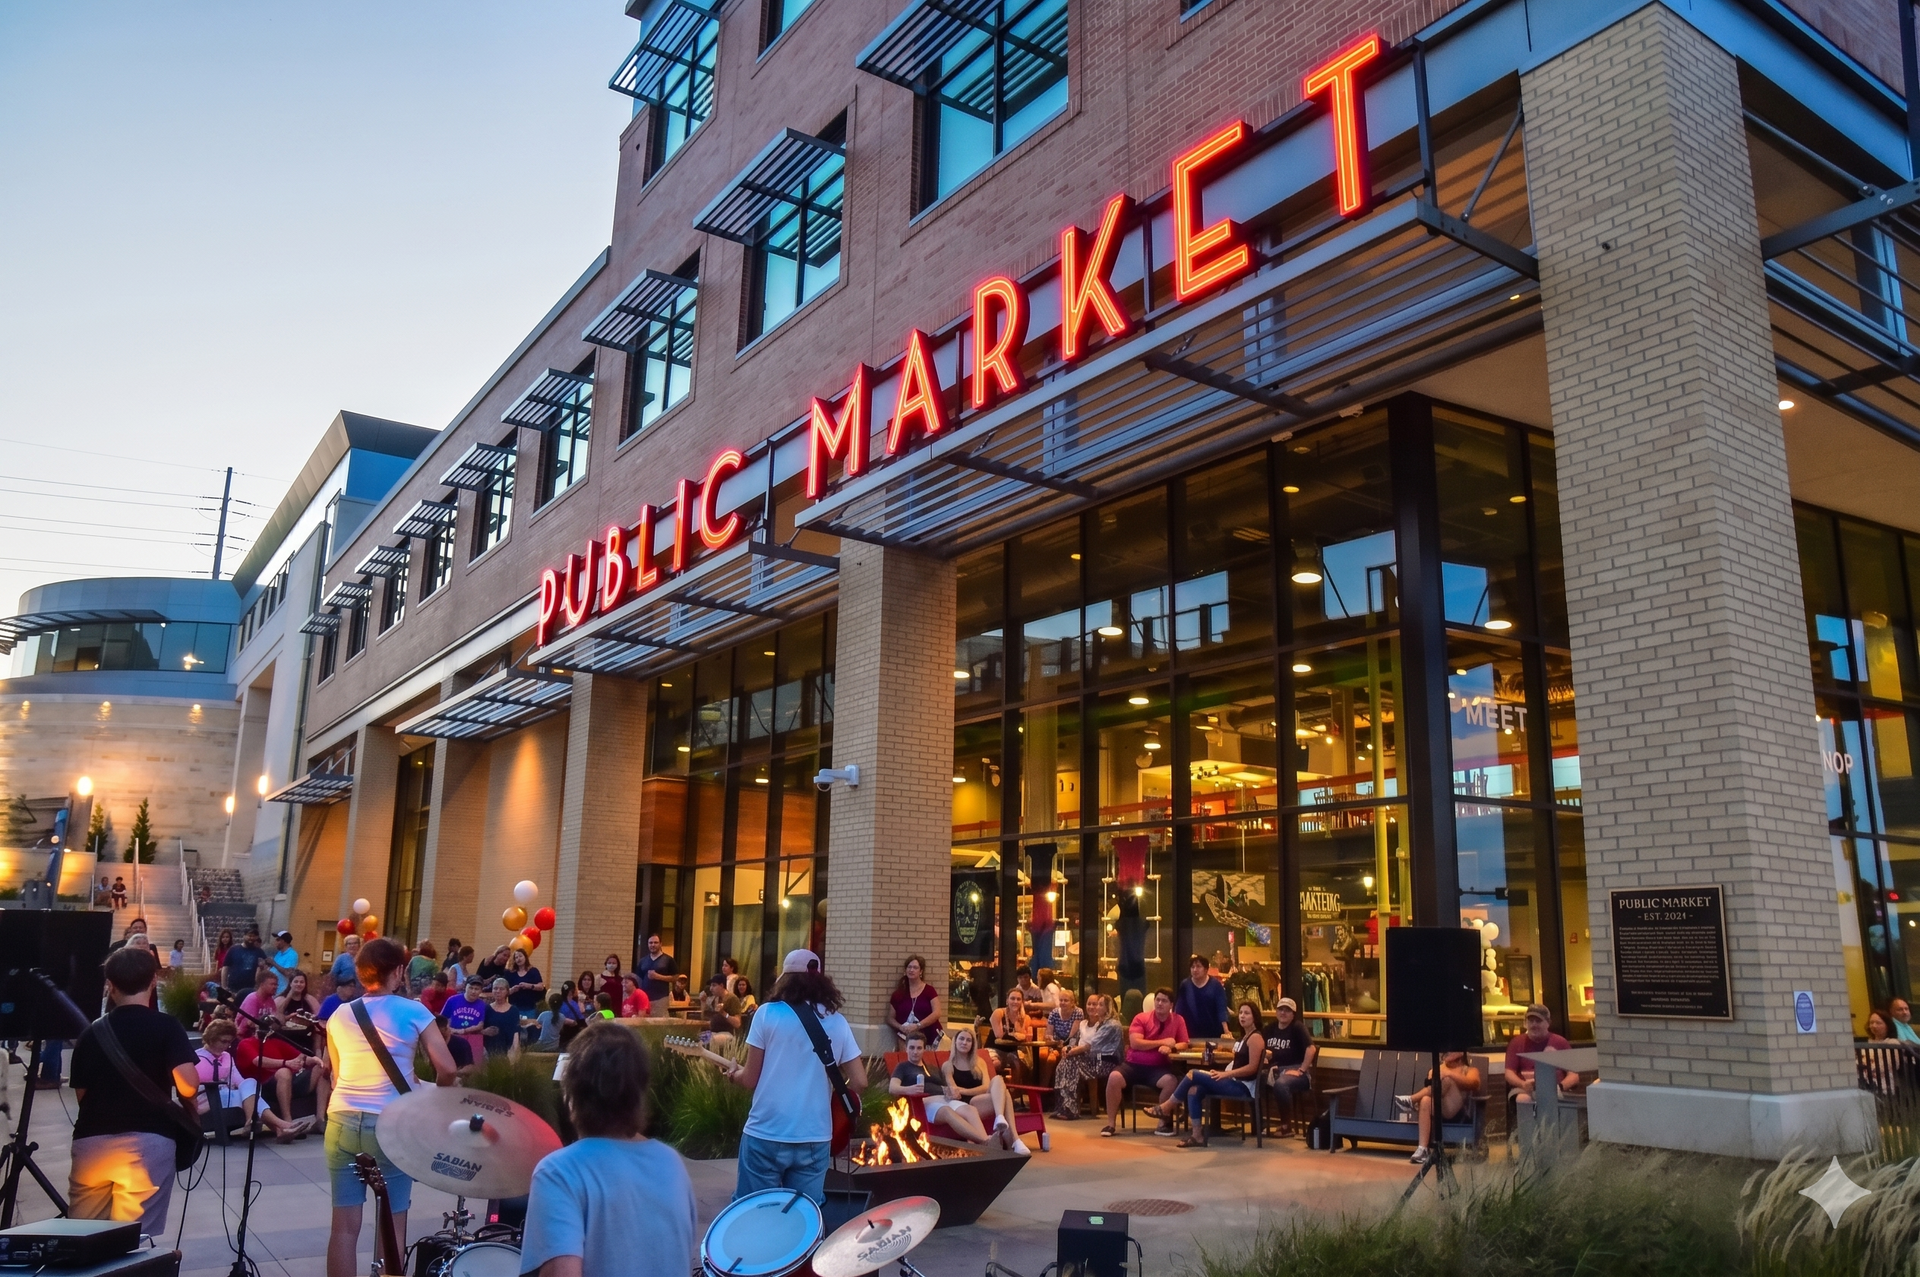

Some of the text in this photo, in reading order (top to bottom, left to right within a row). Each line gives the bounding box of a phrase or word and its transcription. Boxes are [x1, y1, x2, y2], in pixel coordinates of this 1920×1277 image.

[537, 32, 1387, 648] PUBLIC MARKET
[1466, 701, 1528, 732] MEET
[1619, 896, 1712, 909] PUBLIC MARKET
[1643, 912, 1663, 921] EST.
[433, 1152, 482, 1173] SABIAN
[856, 1225, 912, 1261] SABIAN
